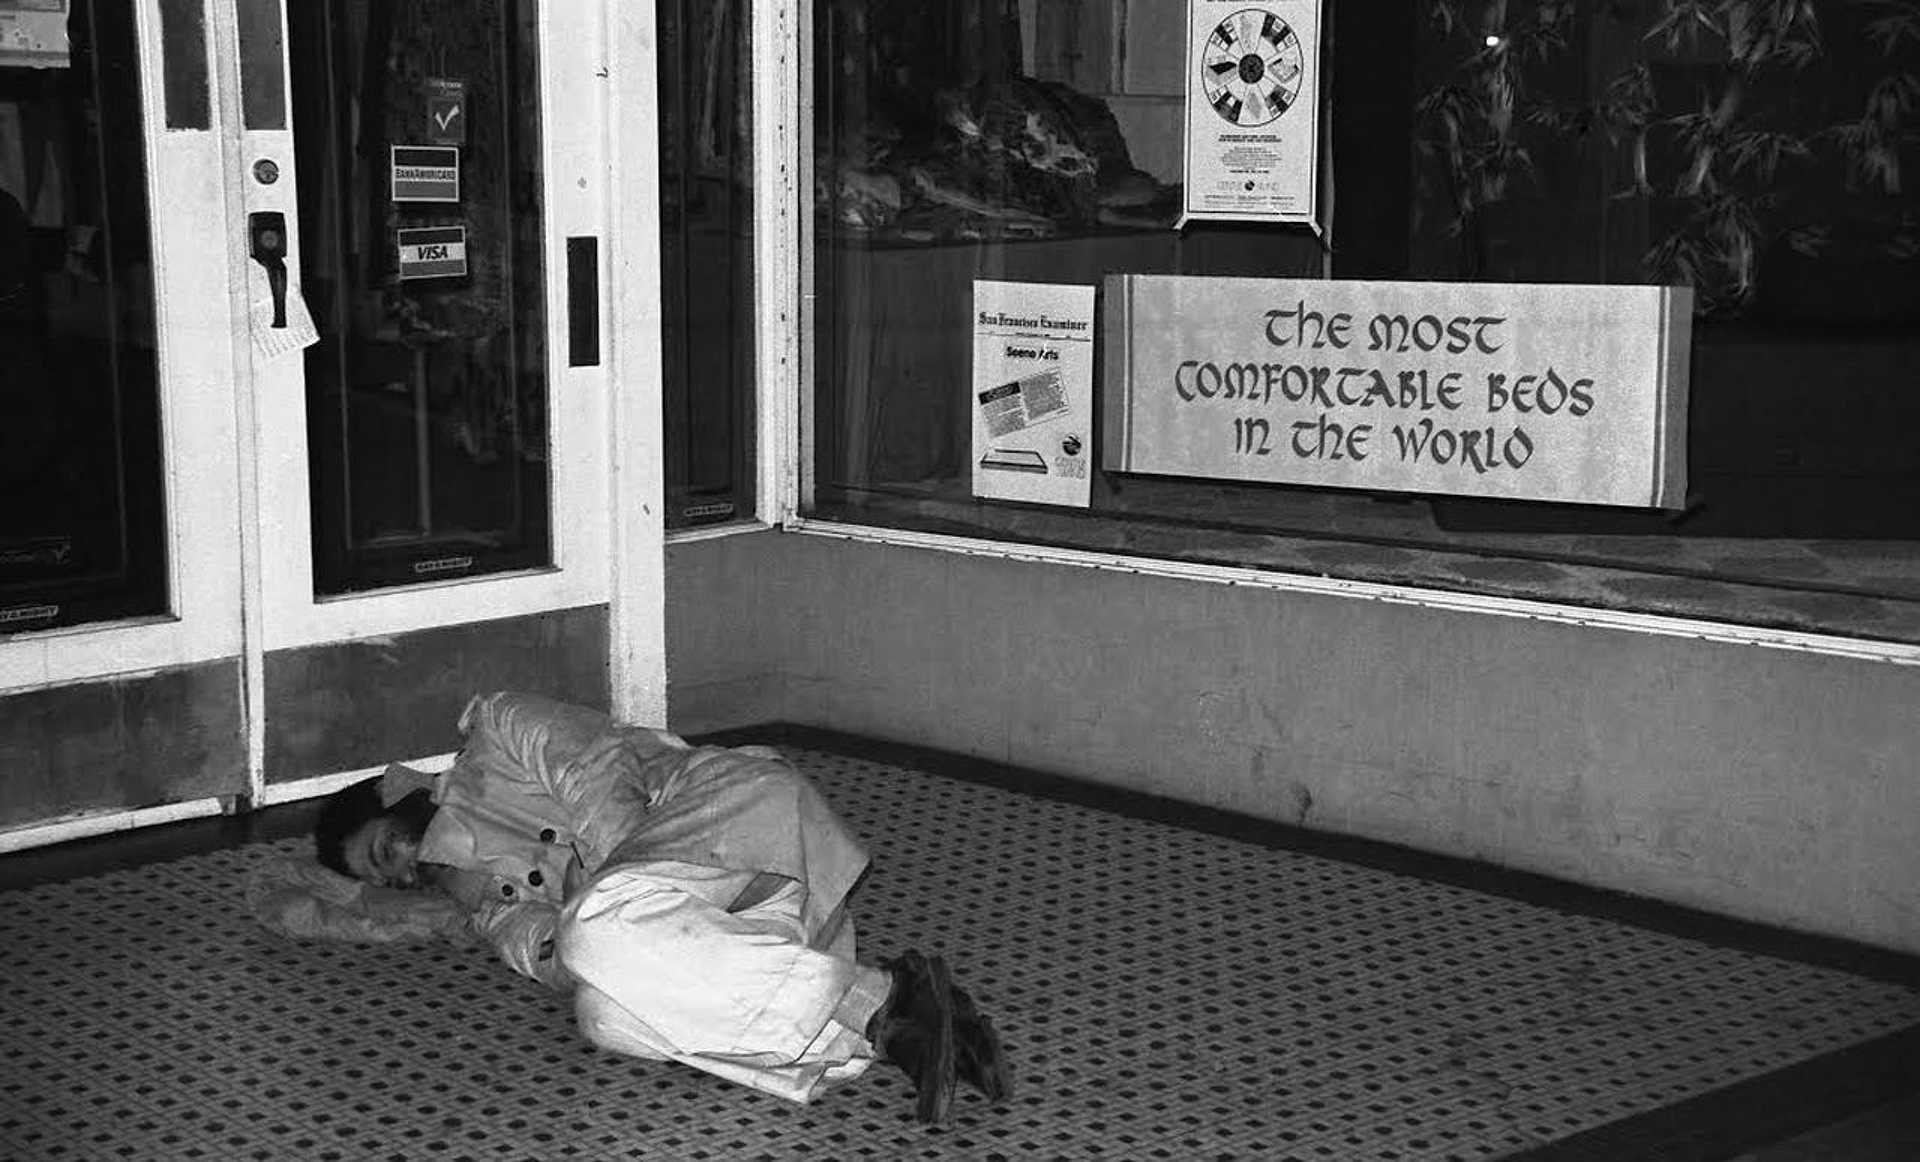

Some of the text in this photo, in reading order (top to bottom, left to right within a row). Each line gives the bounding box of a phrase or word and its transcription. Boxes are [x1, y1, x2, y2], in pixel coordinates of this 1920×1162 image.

[417, 246, 447, 260] VISA
[979, 312, 997, 325] San
[1368, 313, 1506, 354] MOST
[1175, 360, 1595, 416] COMFORTABLE BEDS
[1392, 418, 1534, 474] WORLD
